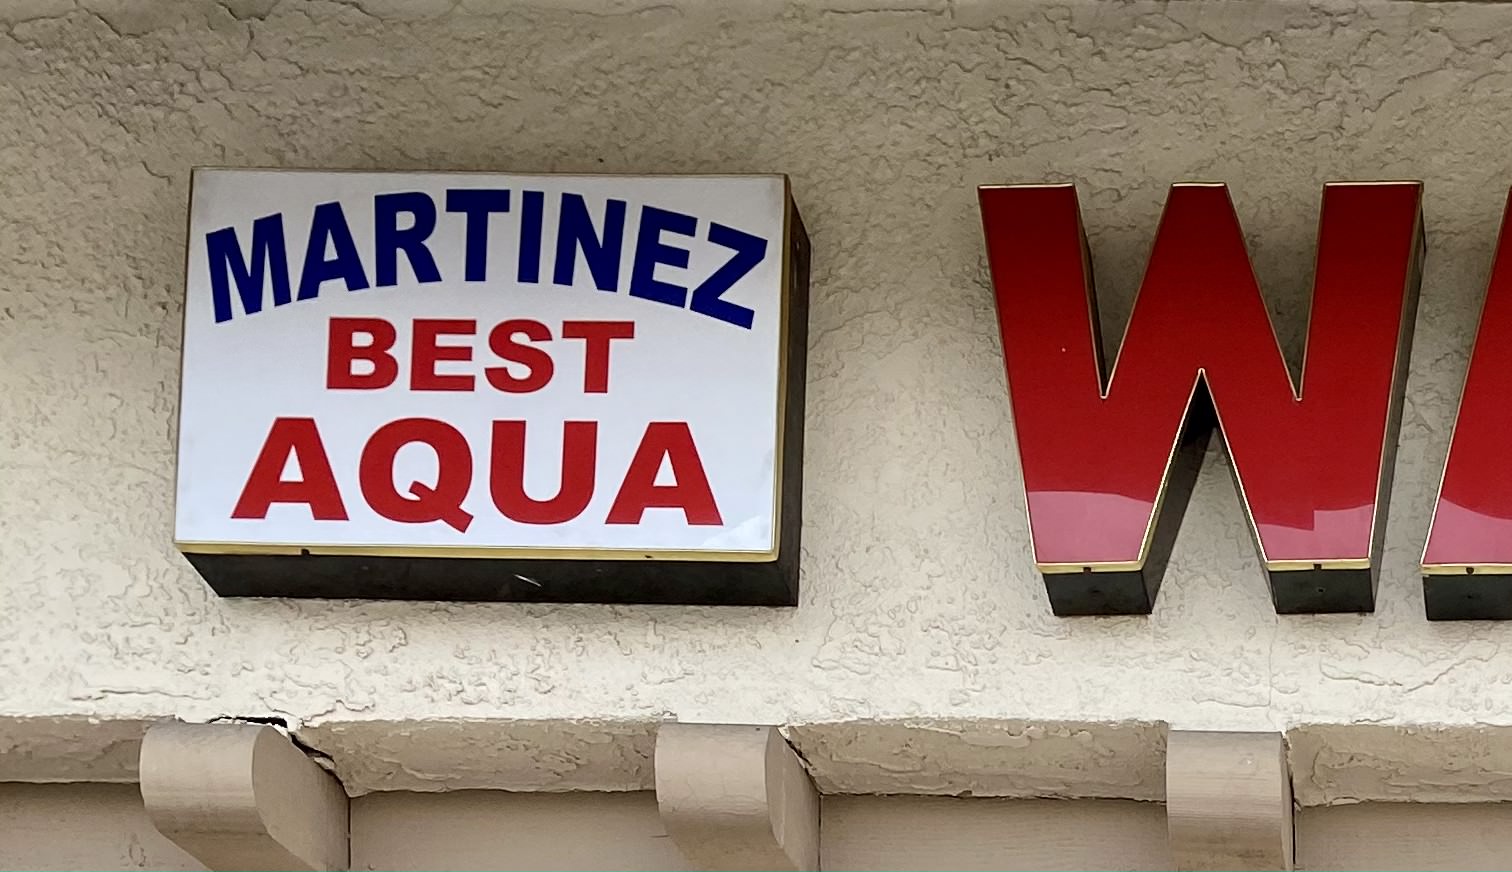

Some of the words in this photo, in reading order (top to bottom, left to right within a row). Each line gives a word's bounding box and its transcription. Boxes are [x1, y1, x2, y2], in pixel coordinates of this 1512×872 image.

[205, 188, 768, 330] MARTINEZ
[326, 317, 635, 394] BEST
[230, 416, 724, 534] AQUA
